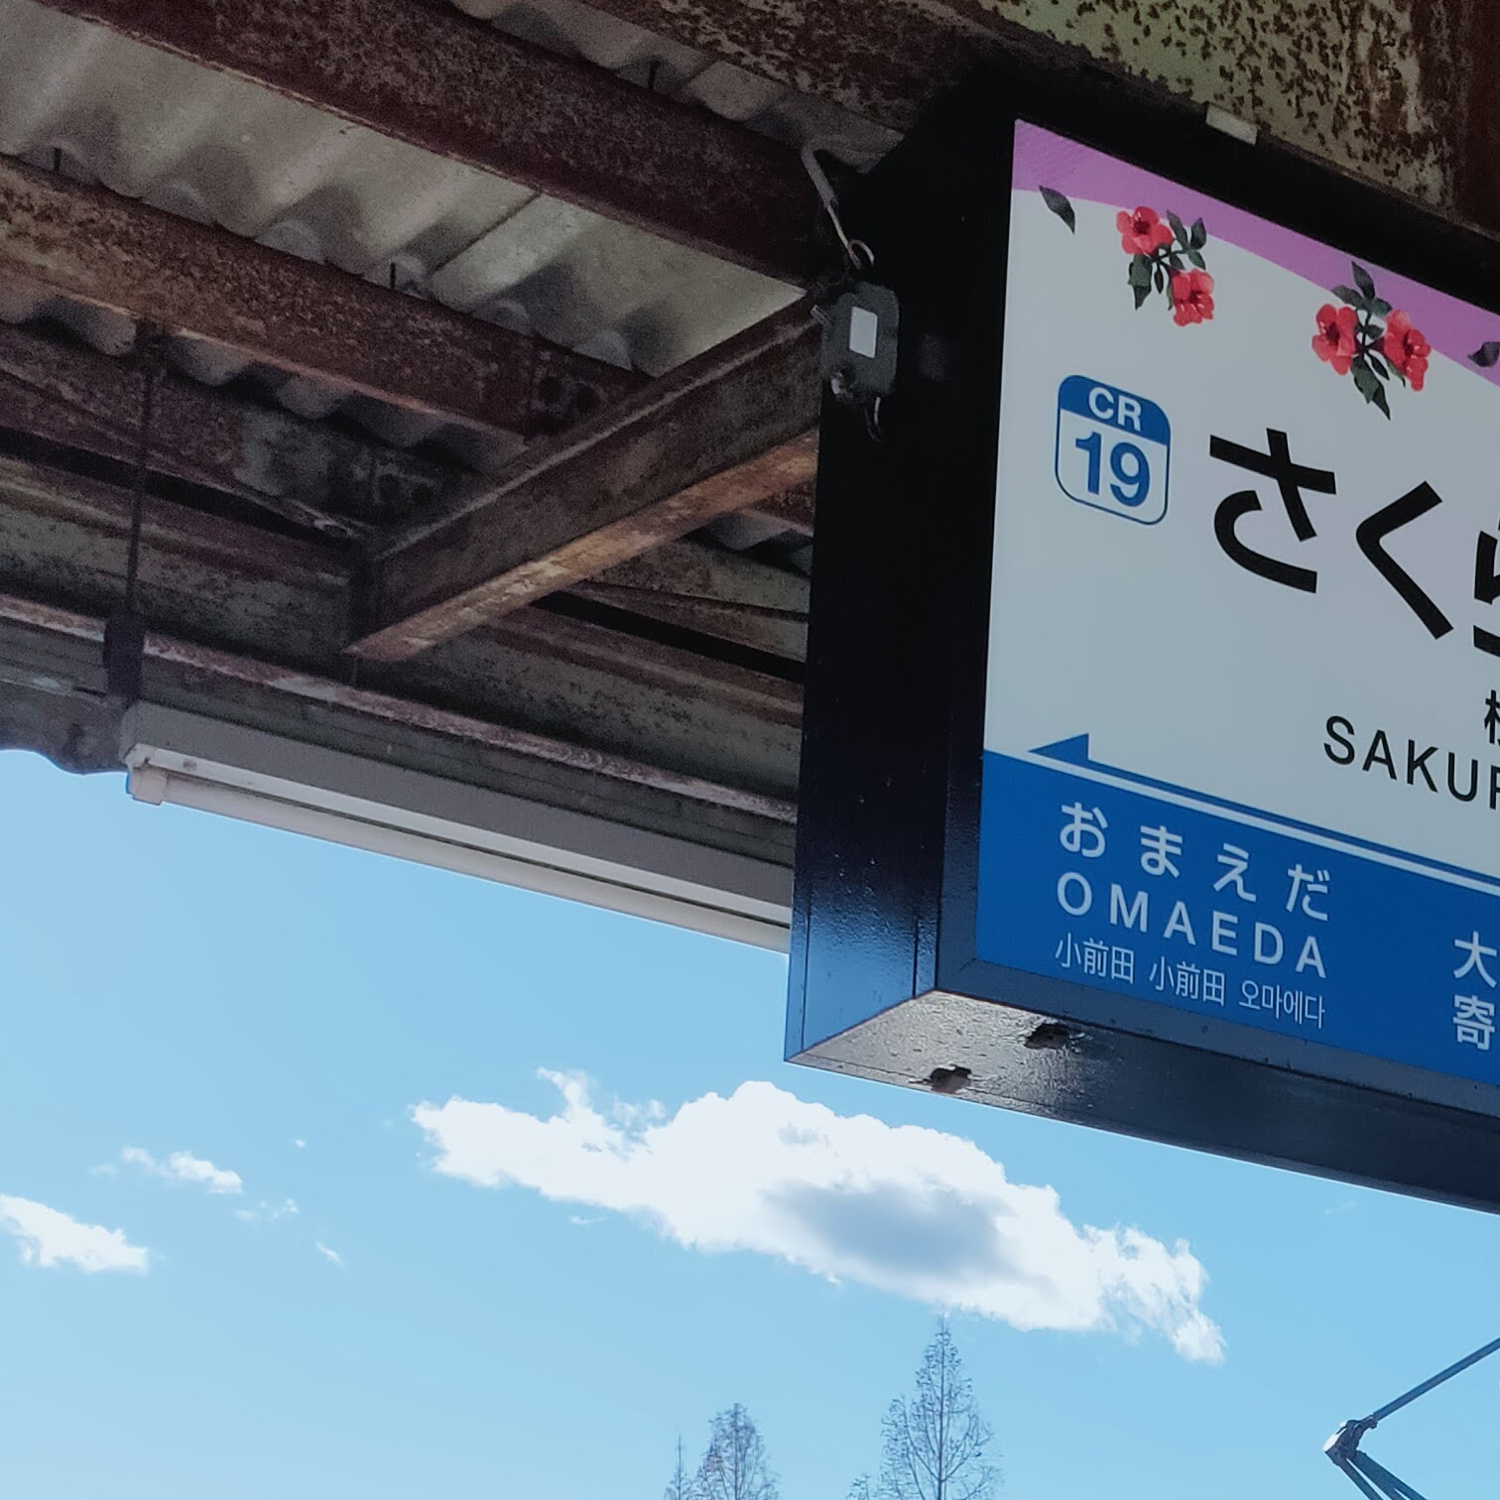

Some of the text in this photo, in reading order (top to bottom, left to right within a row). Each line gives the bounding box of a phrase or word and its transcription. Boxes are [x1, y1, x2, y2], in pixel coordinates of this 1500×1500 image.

[1088, 386, 1142, 432] CR
[1075, 431, 1150, 508] 19
[1058, 801, 1331, 922] おまえだ
[1056, 871, 1327, 979] OMAEDA
[1054, 932, 1326, 1029] 小前田 小前田 오마에다
